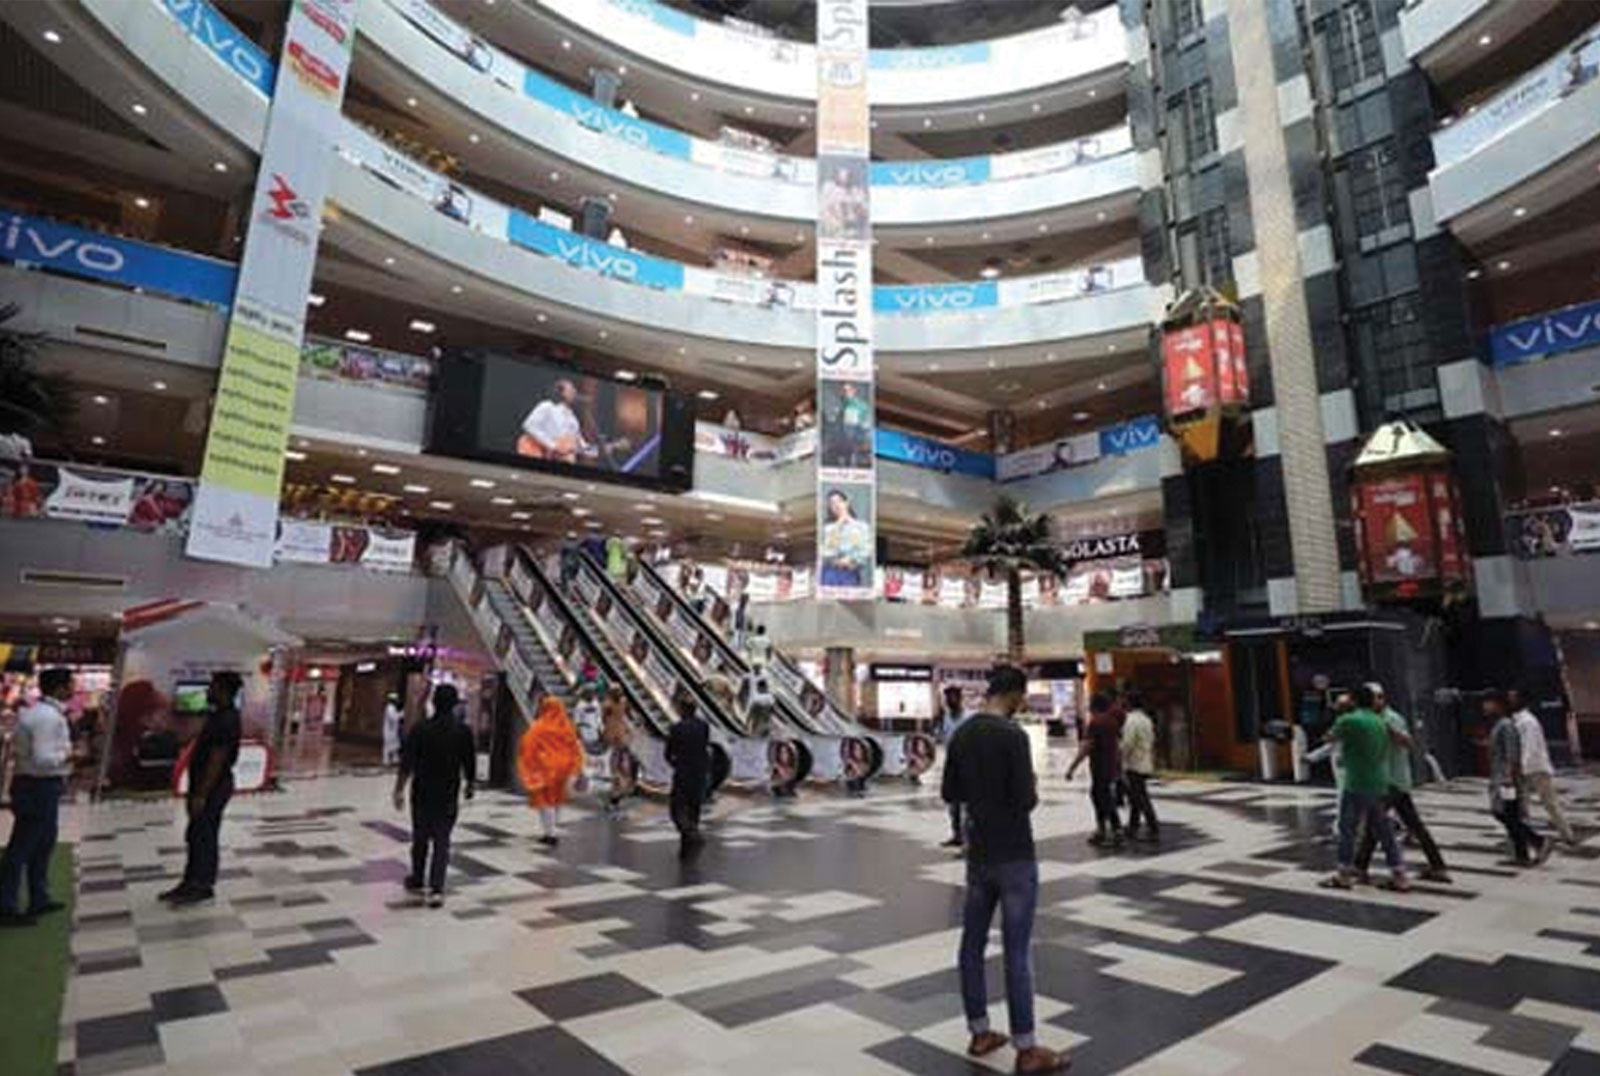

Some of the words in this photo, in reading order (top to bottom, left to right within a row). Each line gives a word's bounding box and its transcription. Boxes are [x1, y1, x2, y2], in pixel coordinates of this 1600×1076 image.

[571, 102, 649, 146] vivo
[890, 162, 967, 188] vivo
[0, 215, 124, 272] ivo
[556, 236, 639, 277] vivo
[821, 249, 869, 367] Splash
[895, 285, 976, 309] vivo
[1506, 313, 1600, 351] viv
[900, 440, 956, 467] vivo
